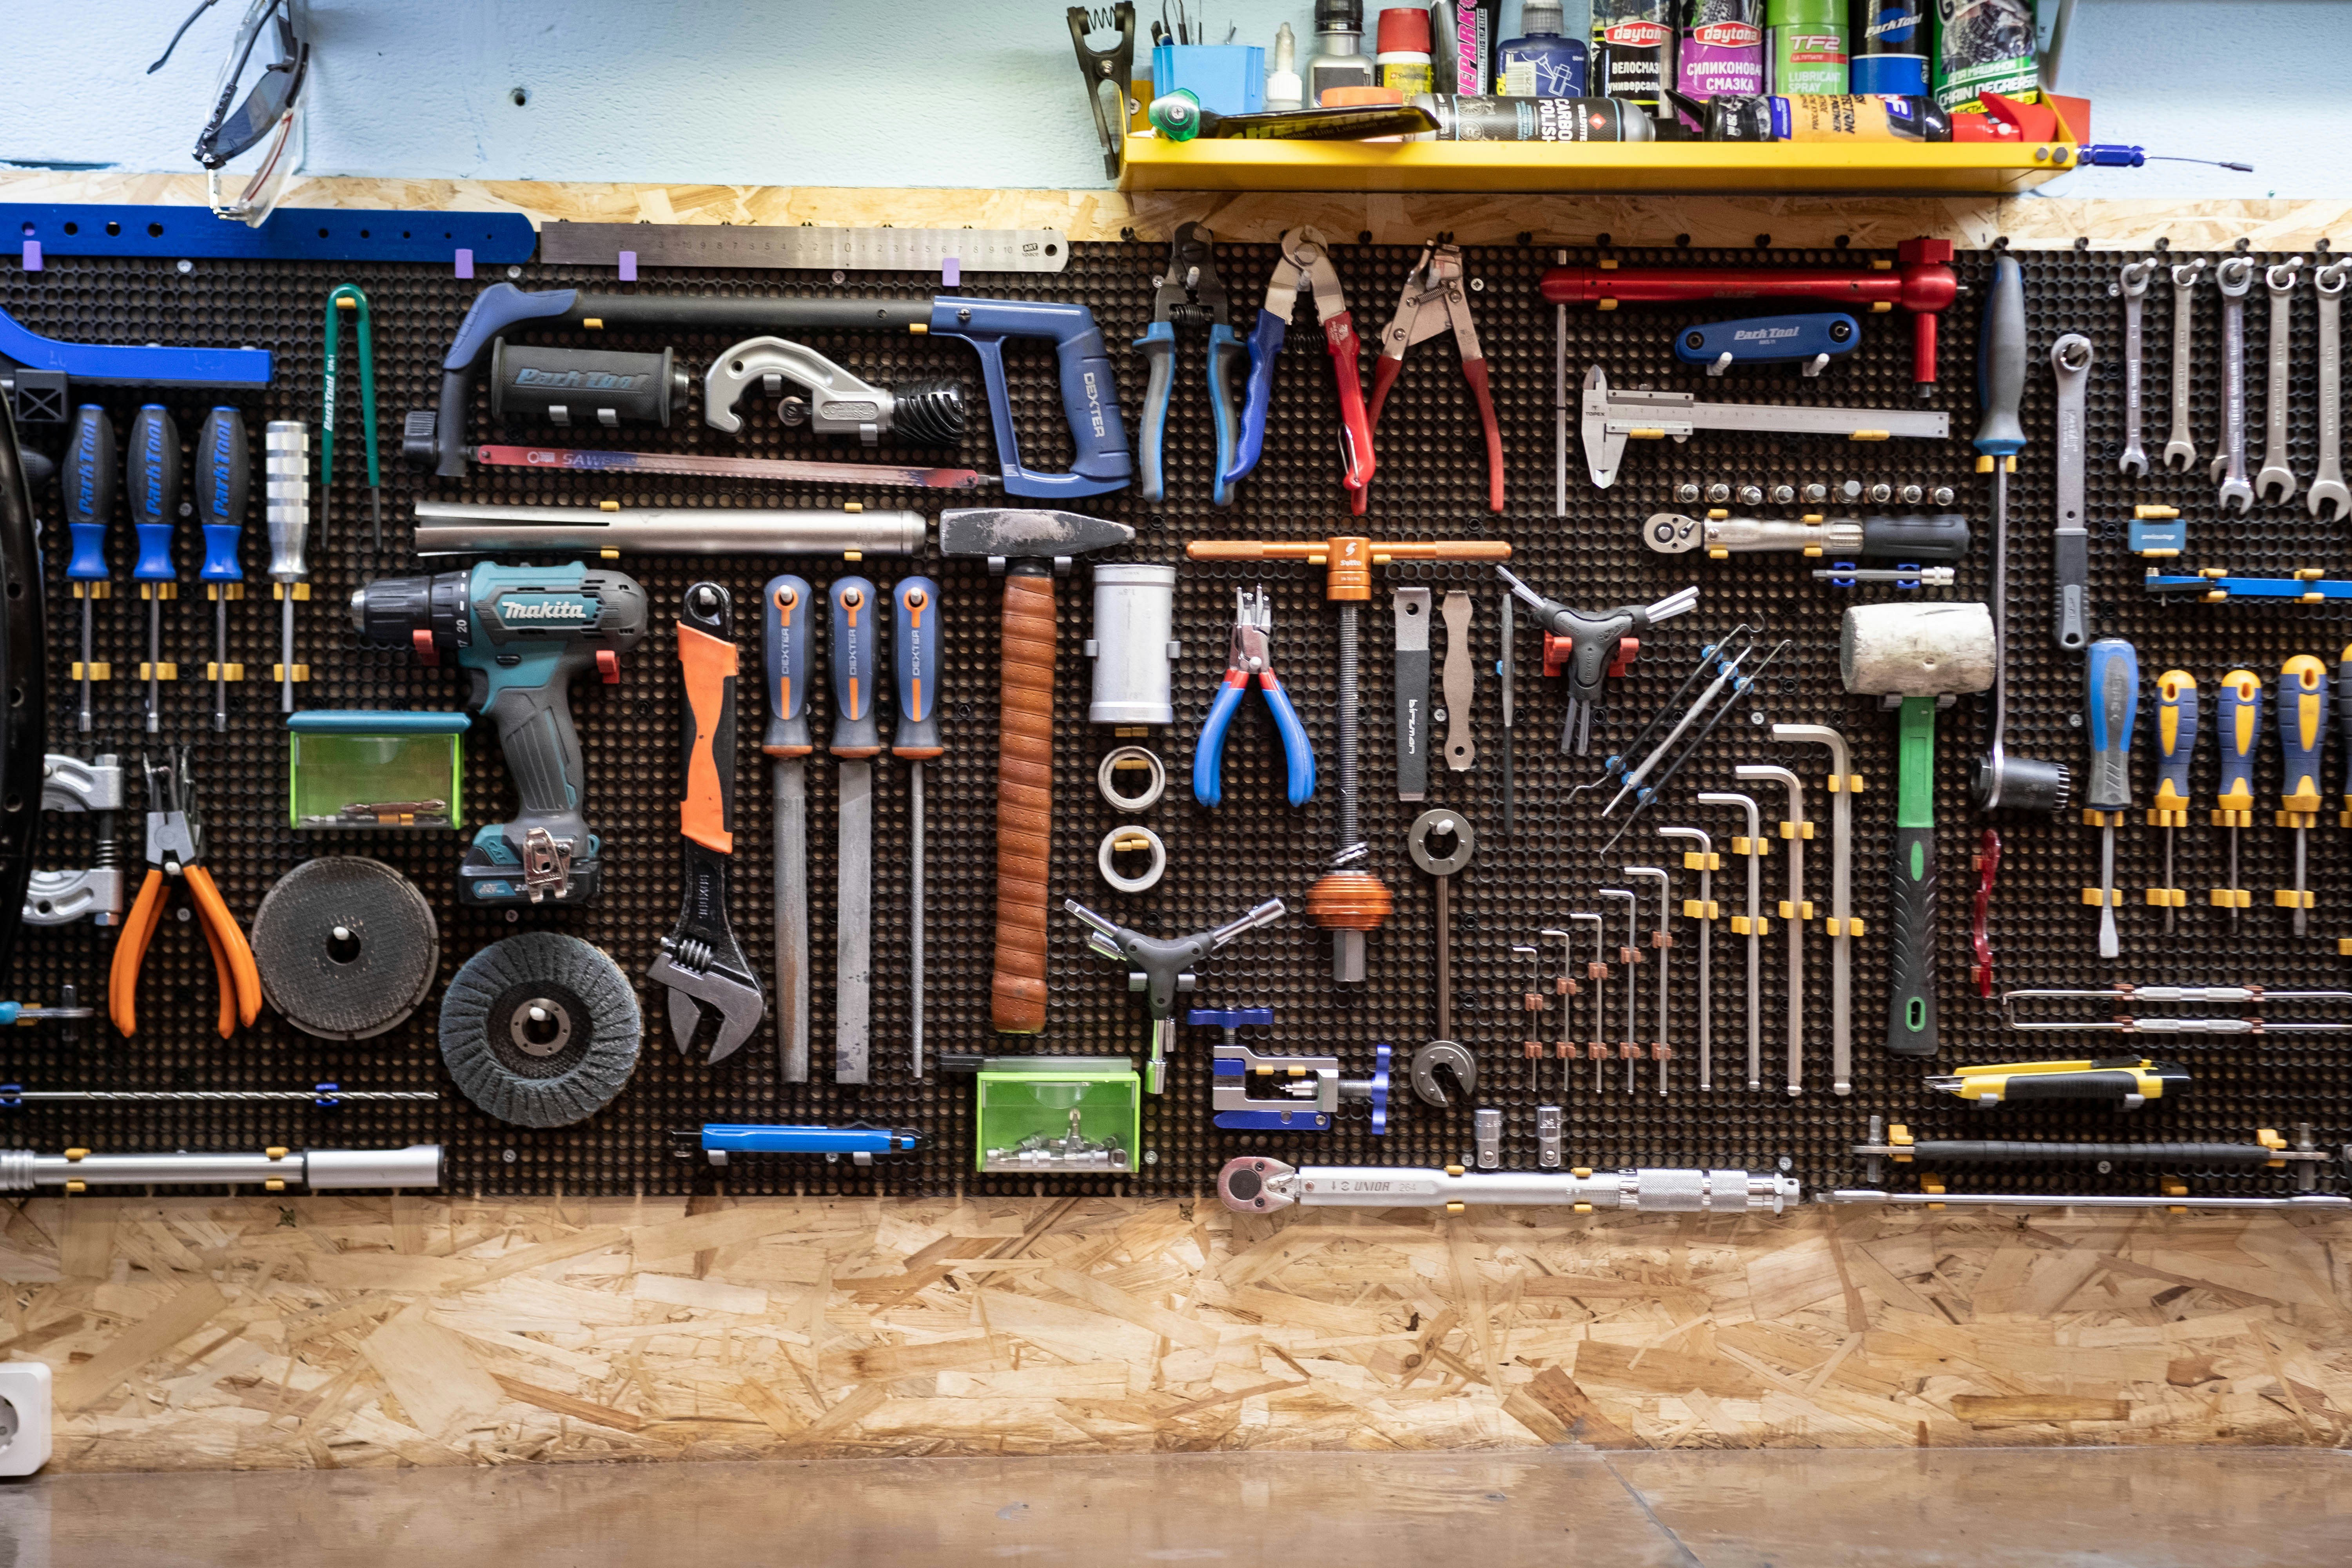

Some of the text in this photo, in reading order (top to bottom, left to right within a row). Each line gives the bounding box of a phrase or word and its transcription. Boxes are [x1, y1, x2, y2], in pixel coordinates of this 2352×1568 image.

[1614, 27, 1662, 42] dayton
[1704, 28, 1757, 42] daytona
[1790, 35, 1840, 51] TF2
[1612, 62, 1660, 74] ВЕЛОСМАЗ
[1706, 78, 1754, 91] СМАЗКА
[1789, 72, 1841, 82] LUBRICANT
[1606, 81, 1660, 94] универсаль
[1789, 83, 1821, 93] SPRAY
[1939, 85, 1973, 106] CHAIN
[1577, 104, 1588, 142] WELDTITE
[844, 242, 851, 253] 0
[941, 245, 947, 253] 6
[1734, 327, 1800, 340] Park Tool
[515, 367, 649, 389] Park Tool
[1083, 371, 1105, 438] DEXTER
[78, 417, 97, 514] ParkTool
[145, 419, 163, 516] ParkTool
[213, 420, 230, 517] ParkTool
[457, 619, 468, 633] 20
[781, 628, 789, 675] DEXTER
[849, 628, 857, 676] DEXTER
[1407, 699, 1418, 755] birzman
[1354, 1181, 1417, 1192] UNIOR 264
